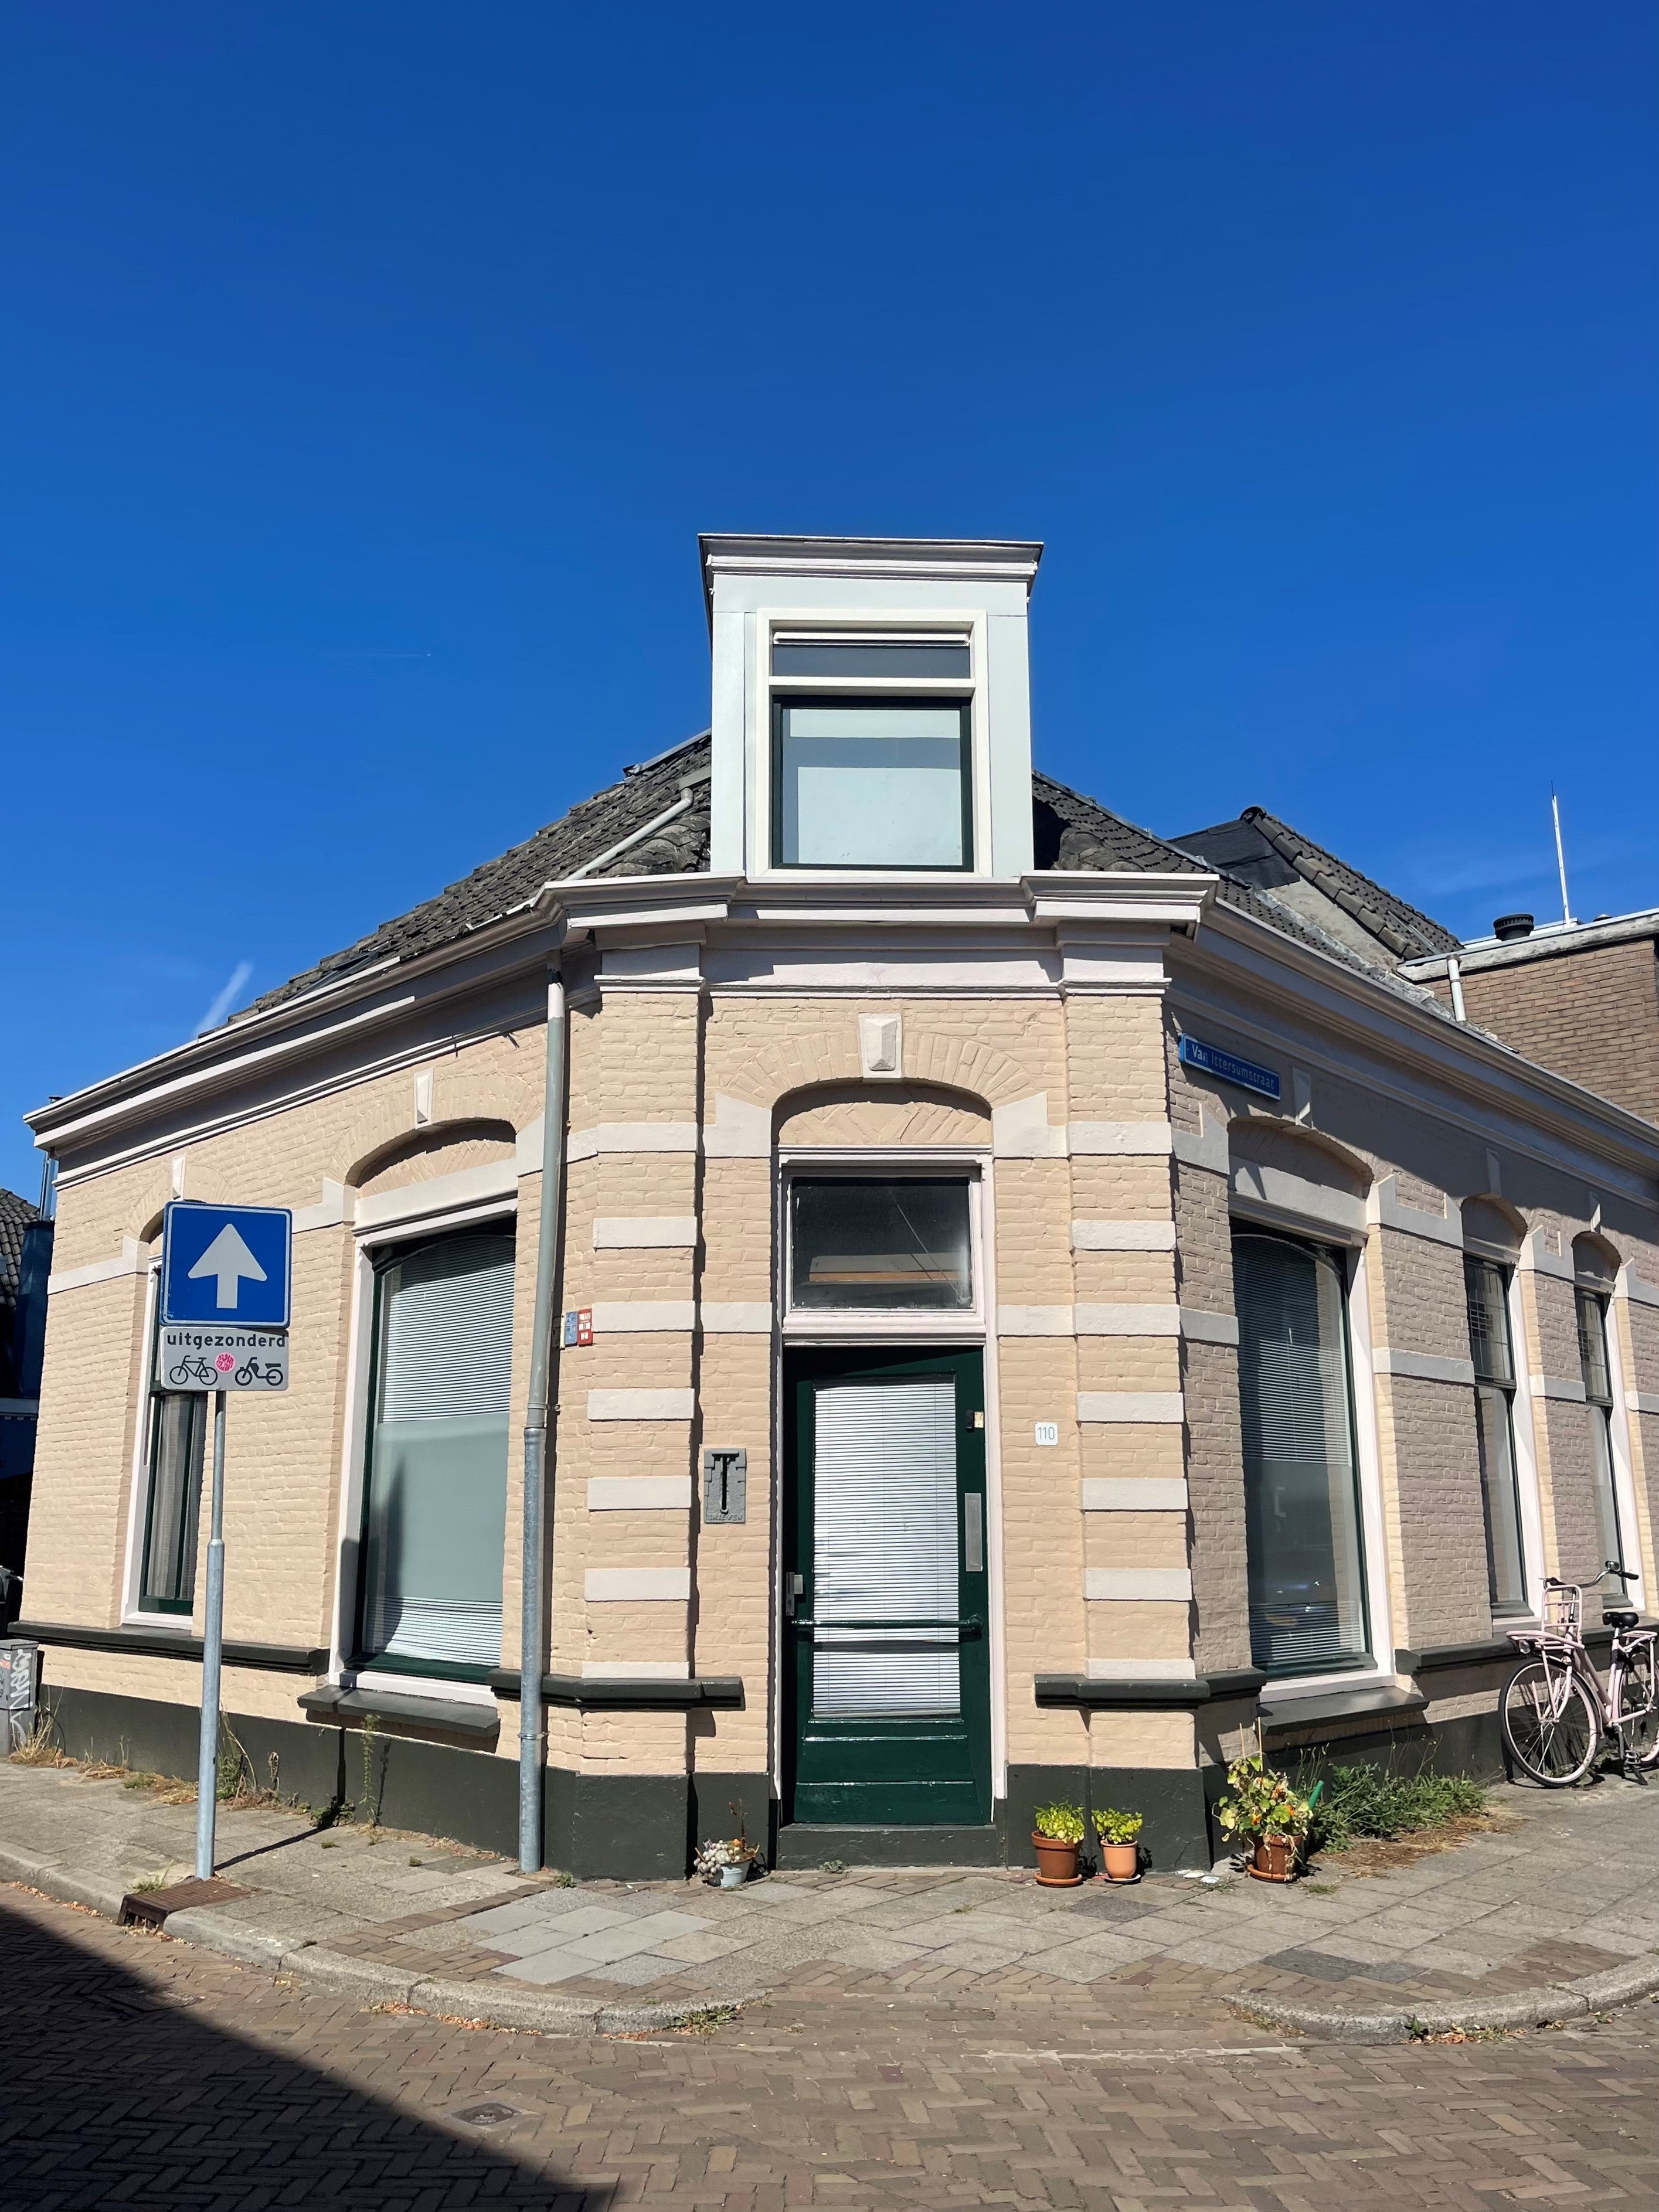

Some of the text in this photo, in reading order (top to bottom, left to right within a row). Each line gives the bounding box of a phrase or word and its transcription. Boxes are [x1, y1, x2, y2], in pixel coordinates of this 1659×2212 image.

[1192, 1043, 1274, 1090] Van Ittersumstraat
[166, 1332, 285, 1350] uitgezonderd
[1038, 1427, 1055, 1440] 110
